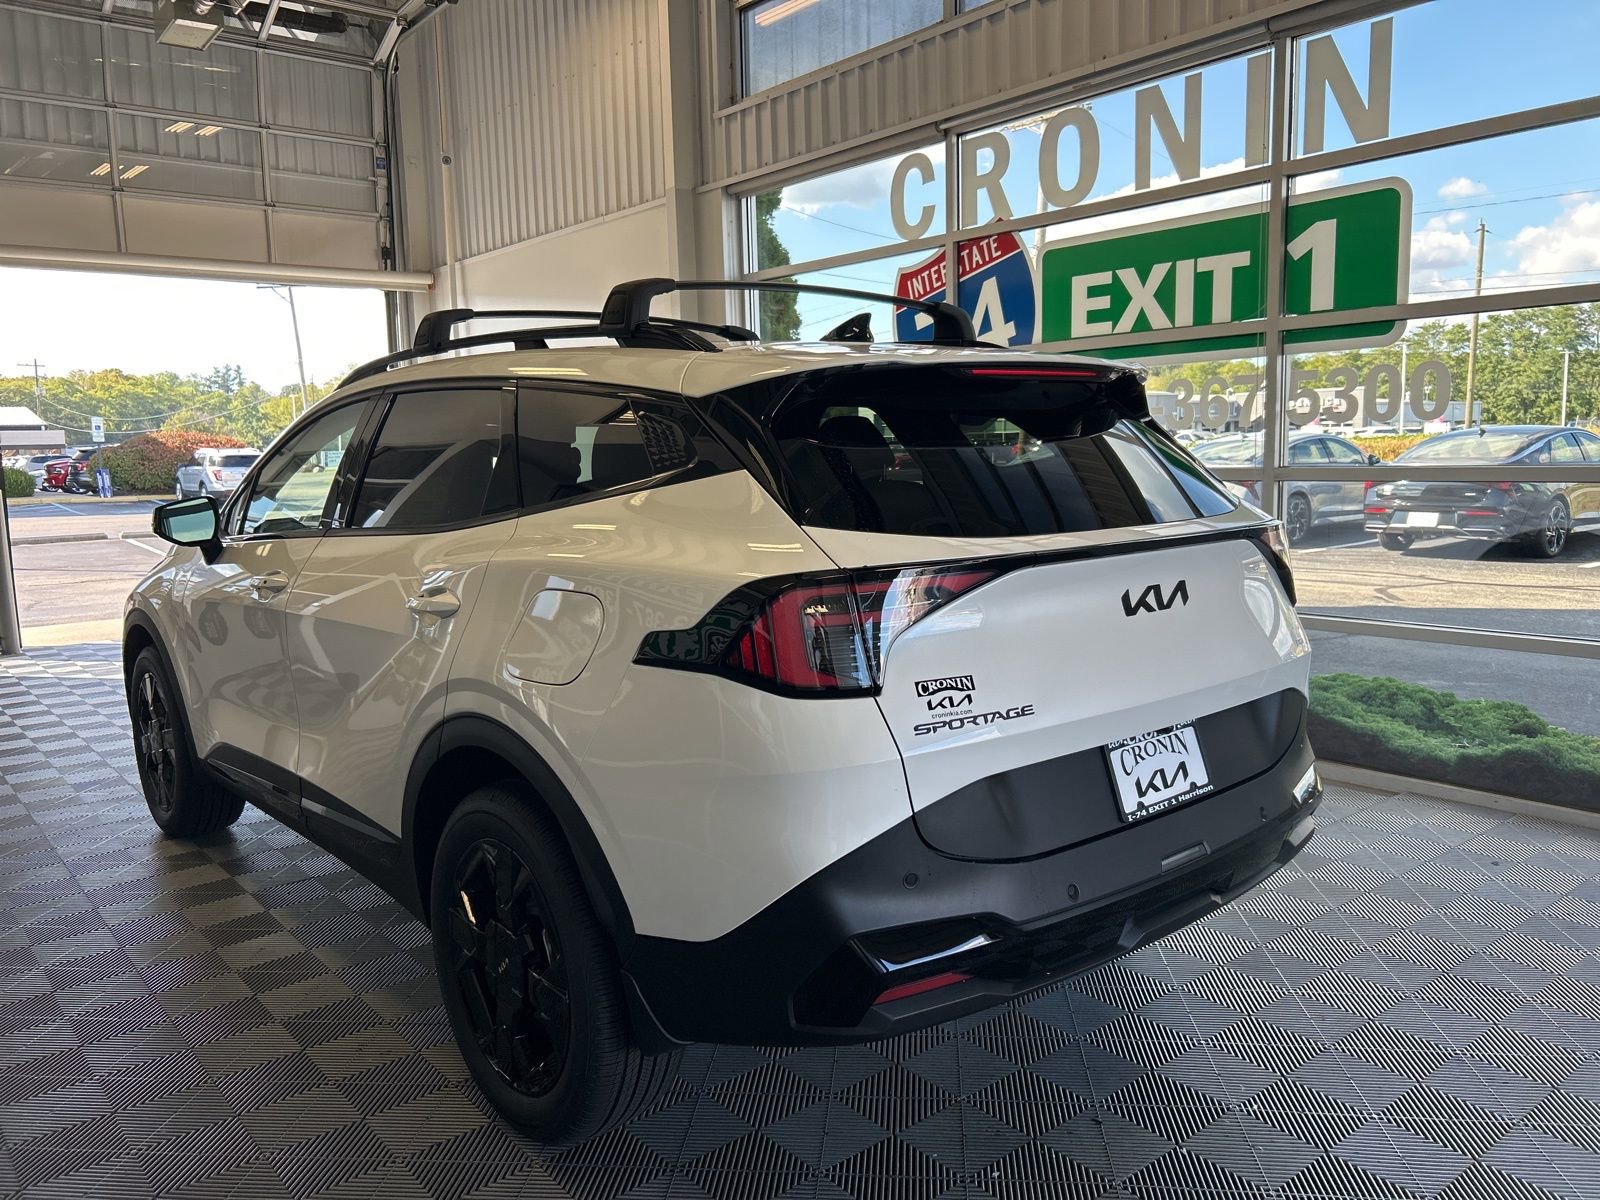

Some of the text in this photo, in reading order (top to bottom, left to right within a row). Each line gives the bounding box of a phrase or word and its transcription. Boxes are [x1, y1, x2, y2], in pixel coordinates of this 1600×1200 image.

[890, 16, 1394, 241] CRONIN
[907, 236, 1001, 300] INTERTATE
[1070, 218, 1337, 338] EXIT 1
[1121, 579, 1189, 617] KIA
[917, 676, 973, 696] CRONIN
[927, 693, 973, 711] KIA
[913, 704, 1035, 736] SPORTAGE
[931, 709, 973, 719] croninkia.com
[1120, 730, 1190, 776] CRONIN
[1135, 760, 1189, 799] KIA
[1127, 809, 1147, 822] I-74
[1148, 800, 1169, 814] EXIT
[1178, 784, 1214, 802] Harrison
